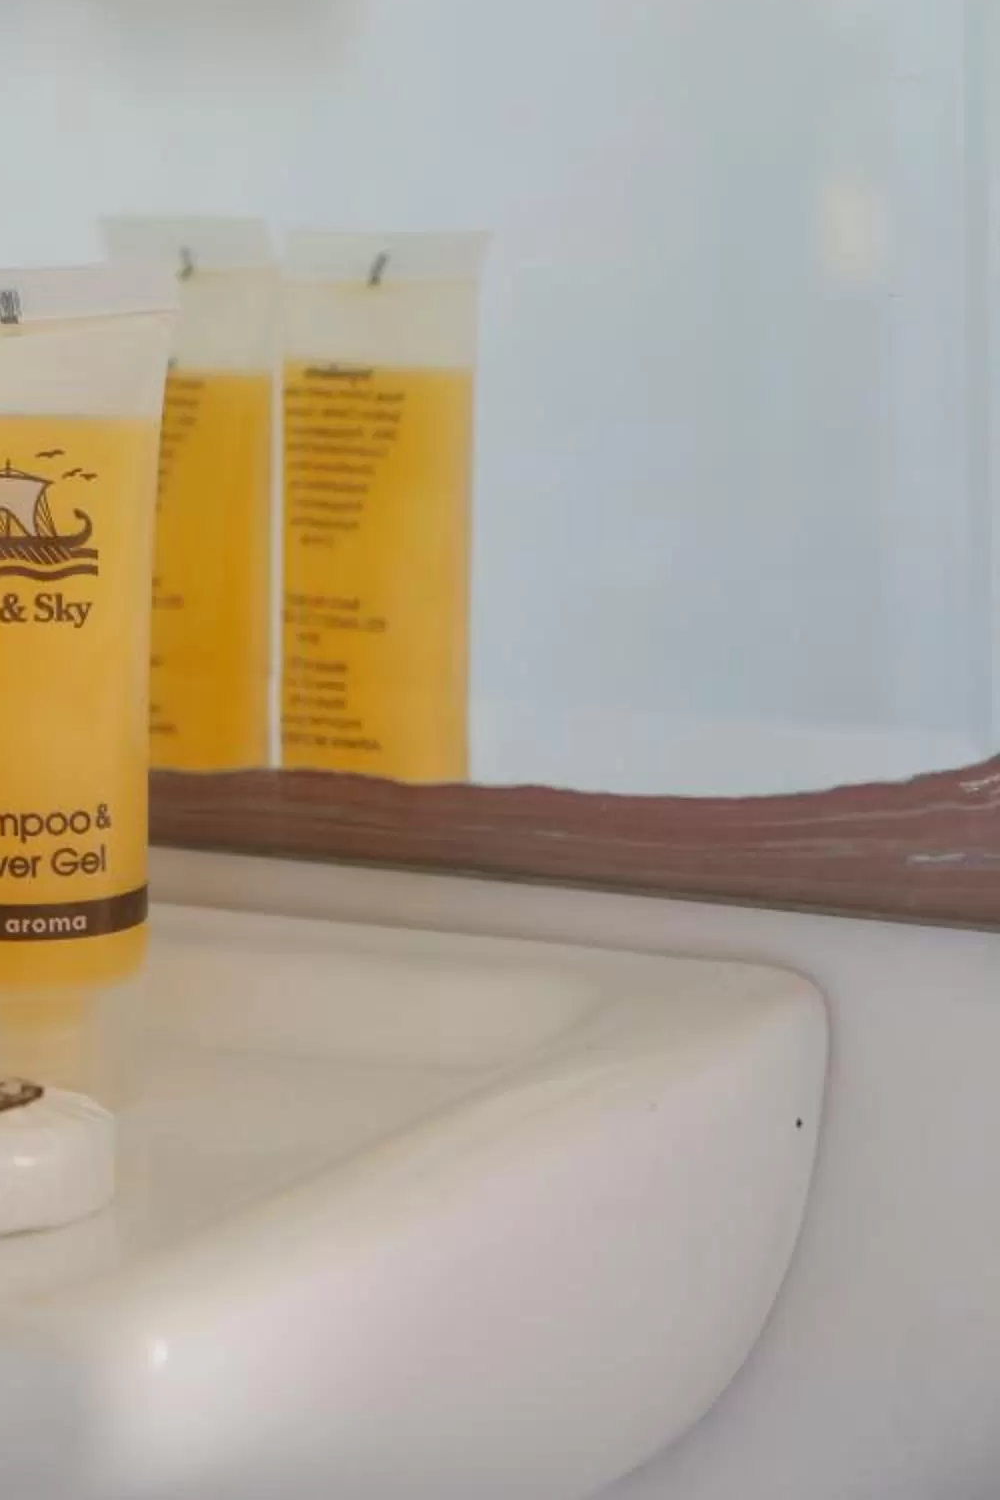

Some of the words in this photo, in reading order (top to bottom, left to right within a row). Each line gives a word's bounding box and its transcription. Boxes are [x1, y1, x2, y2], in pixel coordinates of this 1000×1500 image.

[33, 592, 93, 628] Sky
[96, 803, 111, 829] &
[51, 844, 107, 876] Gel
[5, 914, 88, 933] aroma
